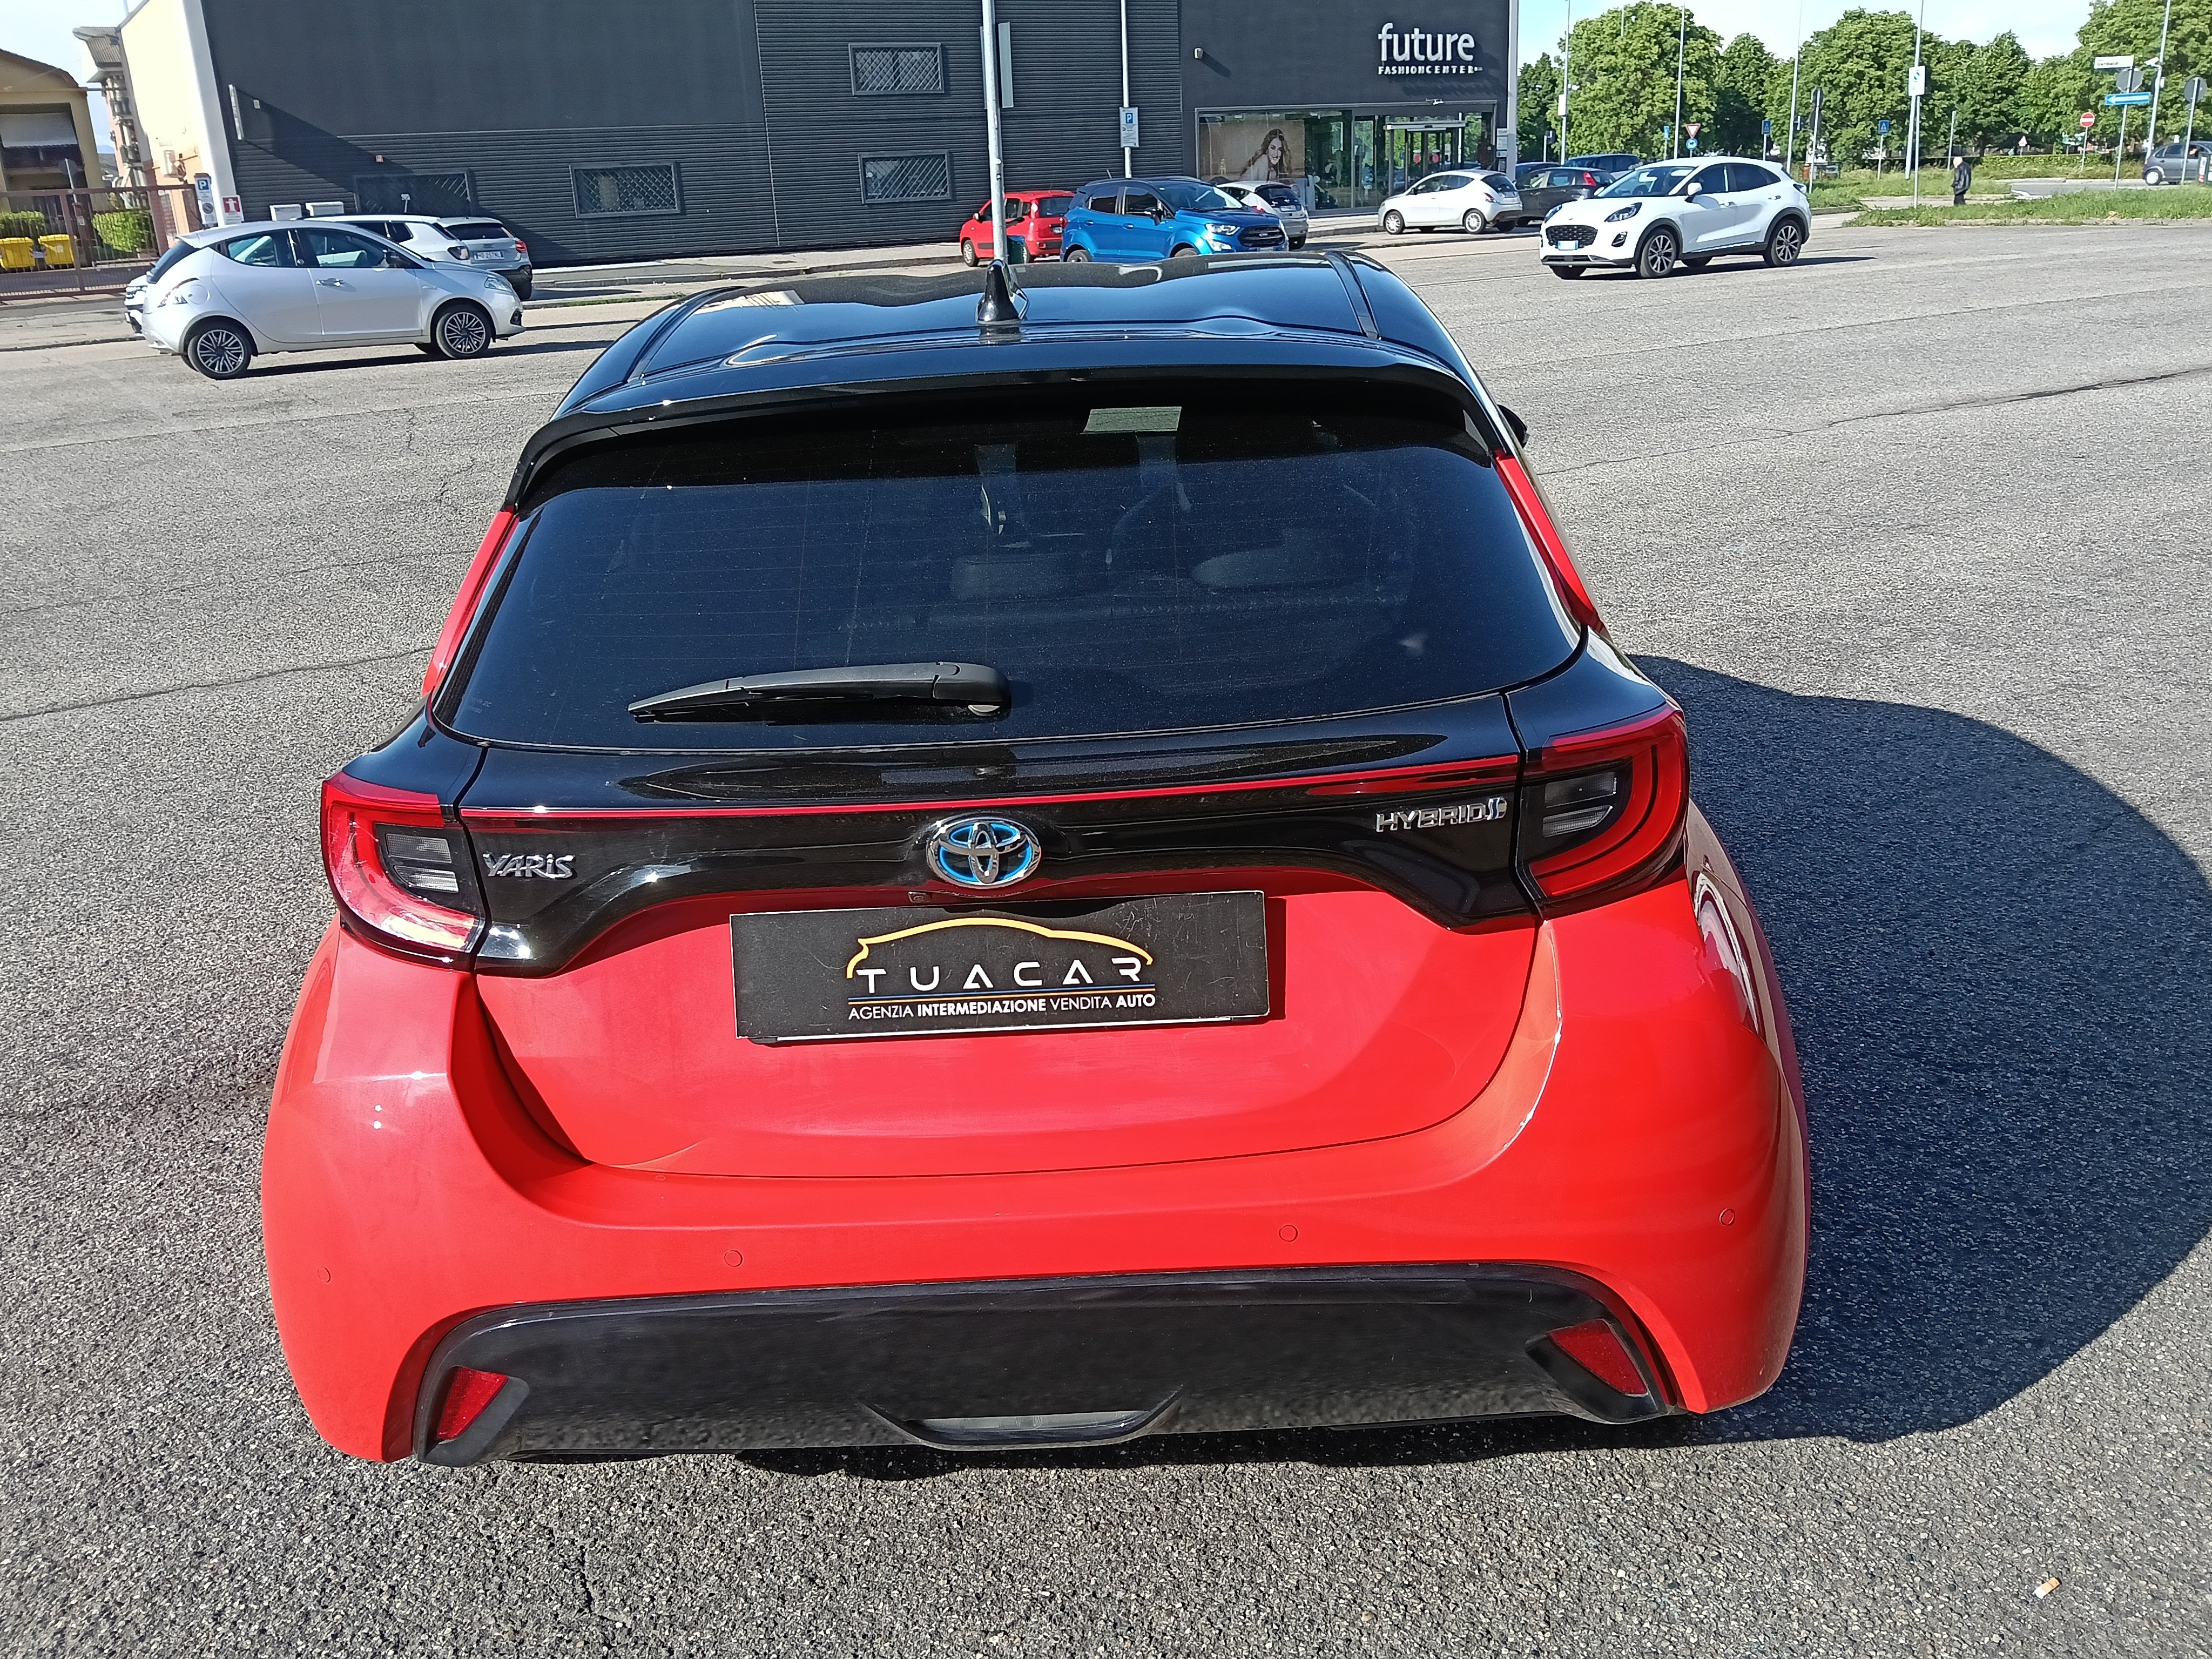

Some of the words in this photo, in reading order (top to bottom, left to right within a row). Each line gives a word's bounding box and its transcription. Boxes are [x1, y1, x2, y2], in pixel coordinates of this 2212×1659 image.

[1378, 23, 1475, 61] future
[1376, 802, 1486, 832] HYBRID
[848, 1004, 914, 1020] AGENZIA
[918, 999, 1046, 1017] INTERMEDIAZIONE
[1050, 996, 1112, 1010] VENDITA
[1116, 994, 1156, 1008] AUTO
